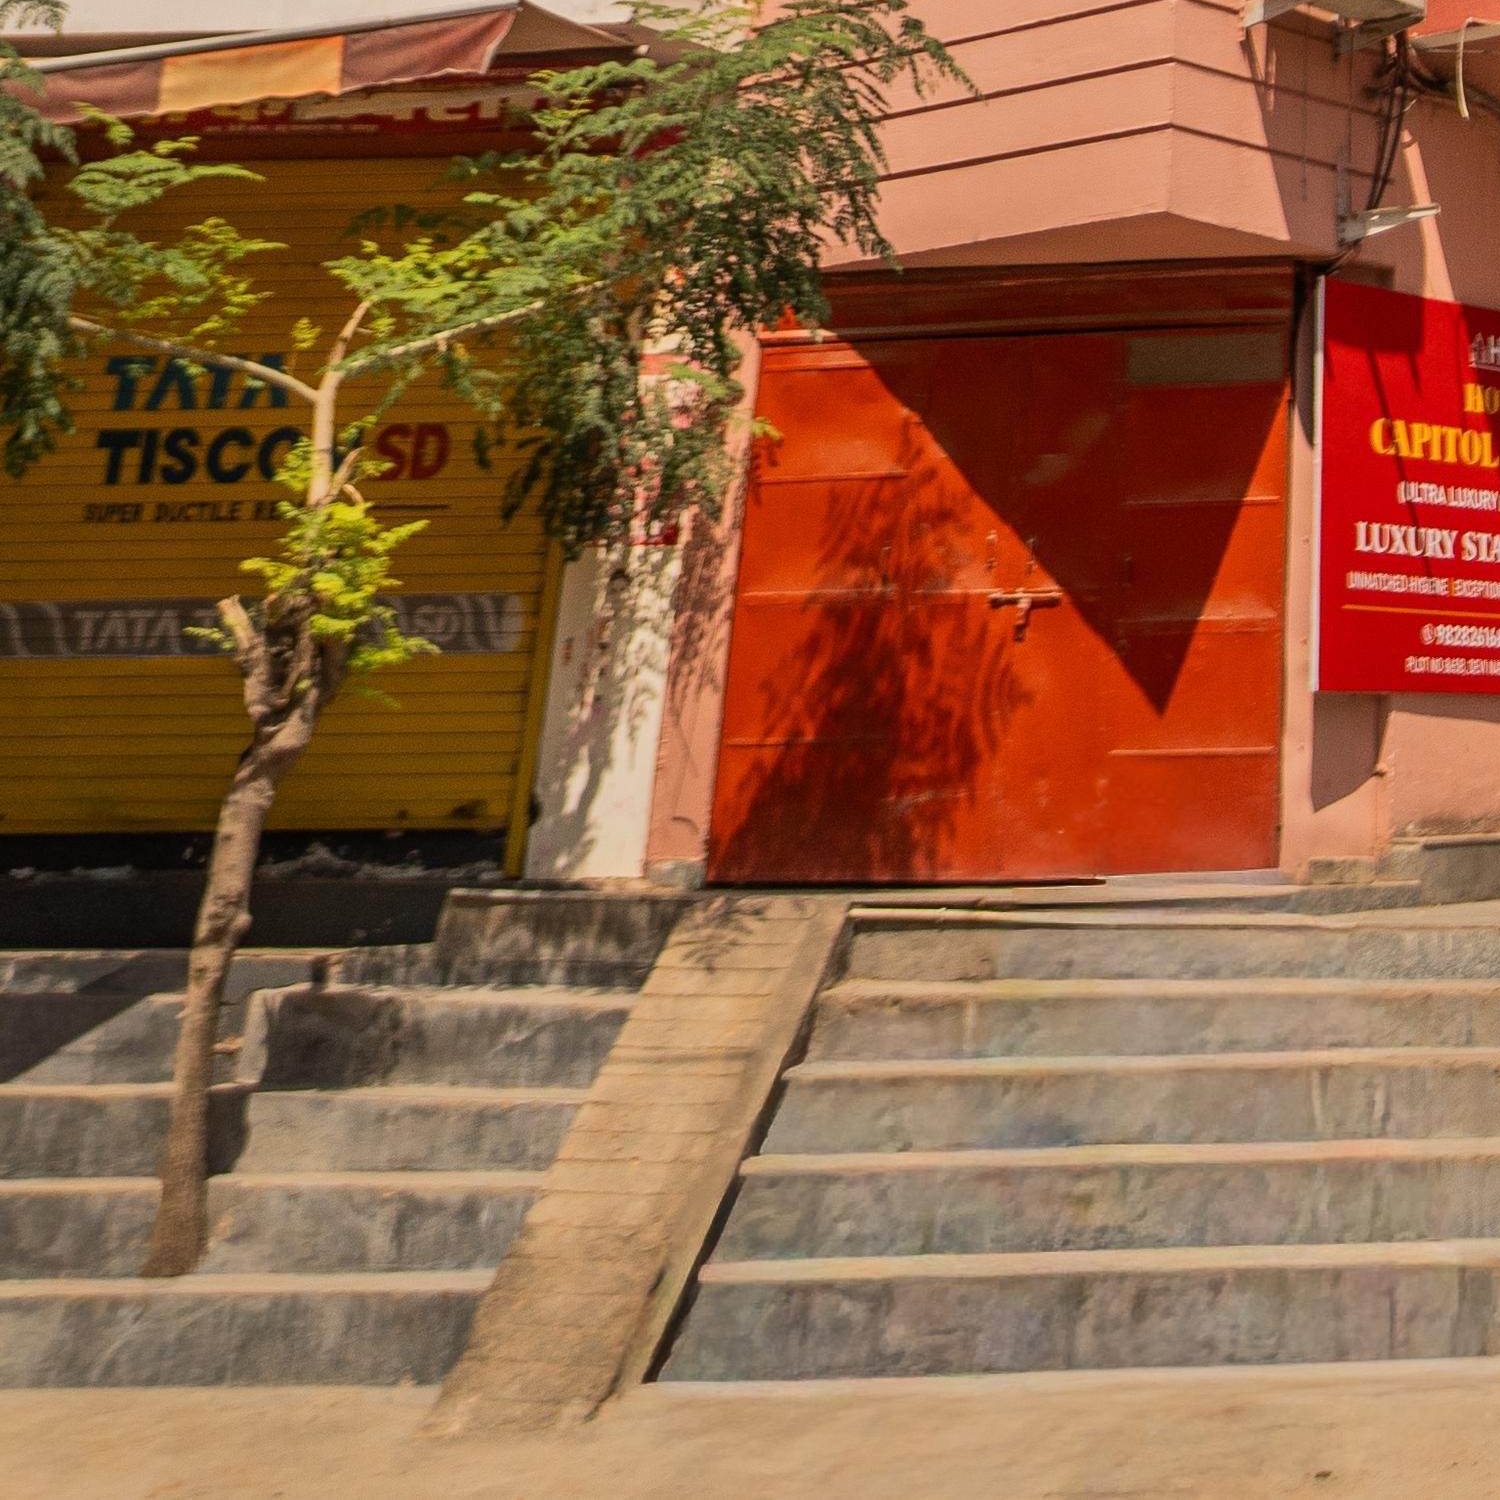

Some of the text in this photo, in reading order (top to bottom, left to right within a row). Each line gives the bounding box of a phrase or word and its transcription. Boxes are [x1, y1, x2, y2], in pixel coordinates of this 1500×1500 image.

[104, 354, 290, 413] TATA
[97, 422, 452, 486] TISCO SD
[1369, 416, 1500, 468] CAPITOL
[1447, 485, 1500, 512] LUXURY
[1353, 520, 1458, 559] LUXURY
